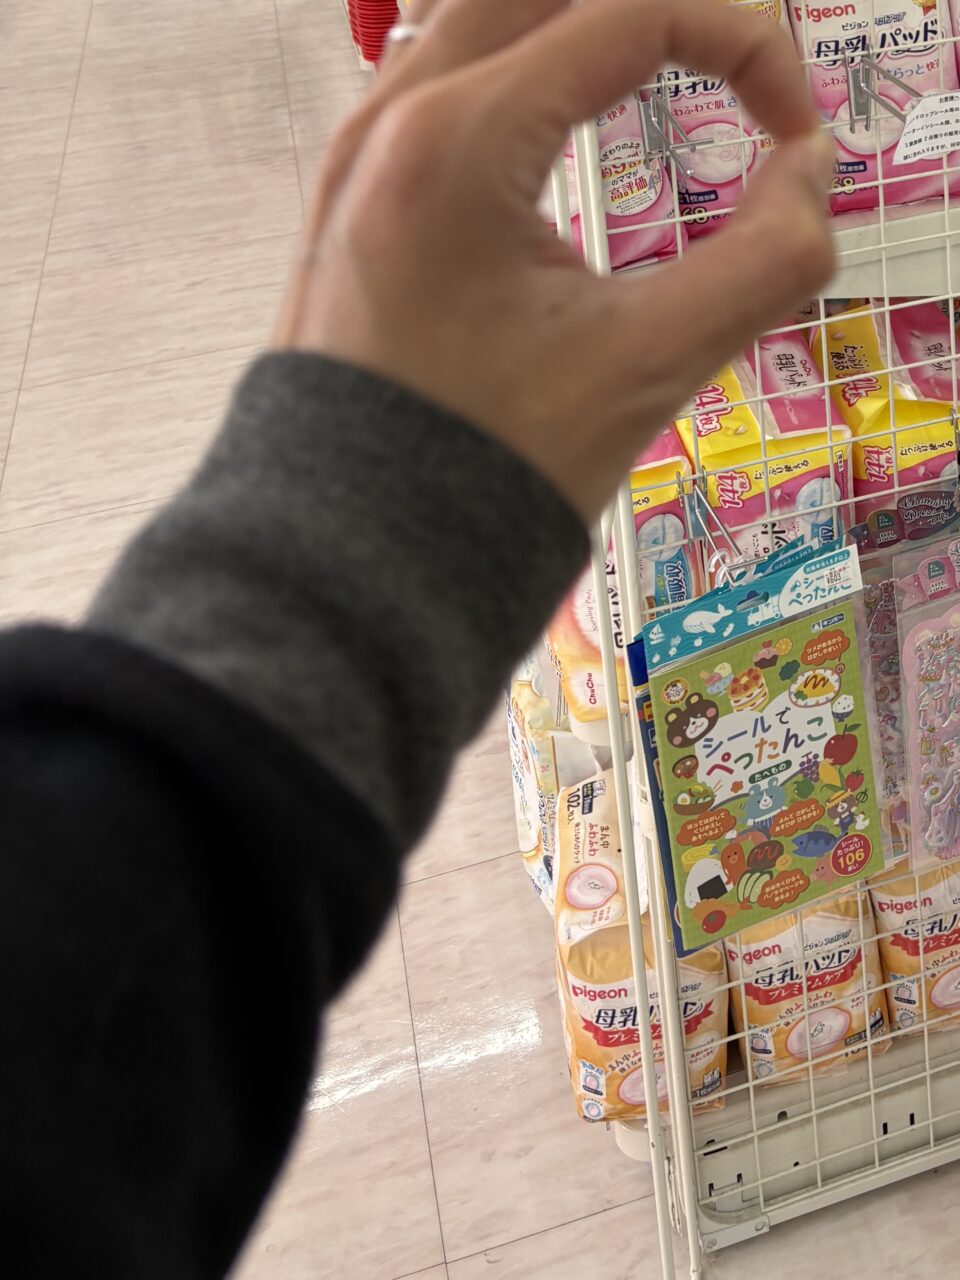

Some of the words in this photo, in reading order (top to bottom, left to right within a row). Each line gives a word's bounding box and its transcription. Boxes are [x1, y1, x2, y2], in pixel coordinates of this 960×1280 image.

[754, 763, 787, 781] たべもの
[841, 837, 859, 847] シール
[838, 850, 865, 869] 106
